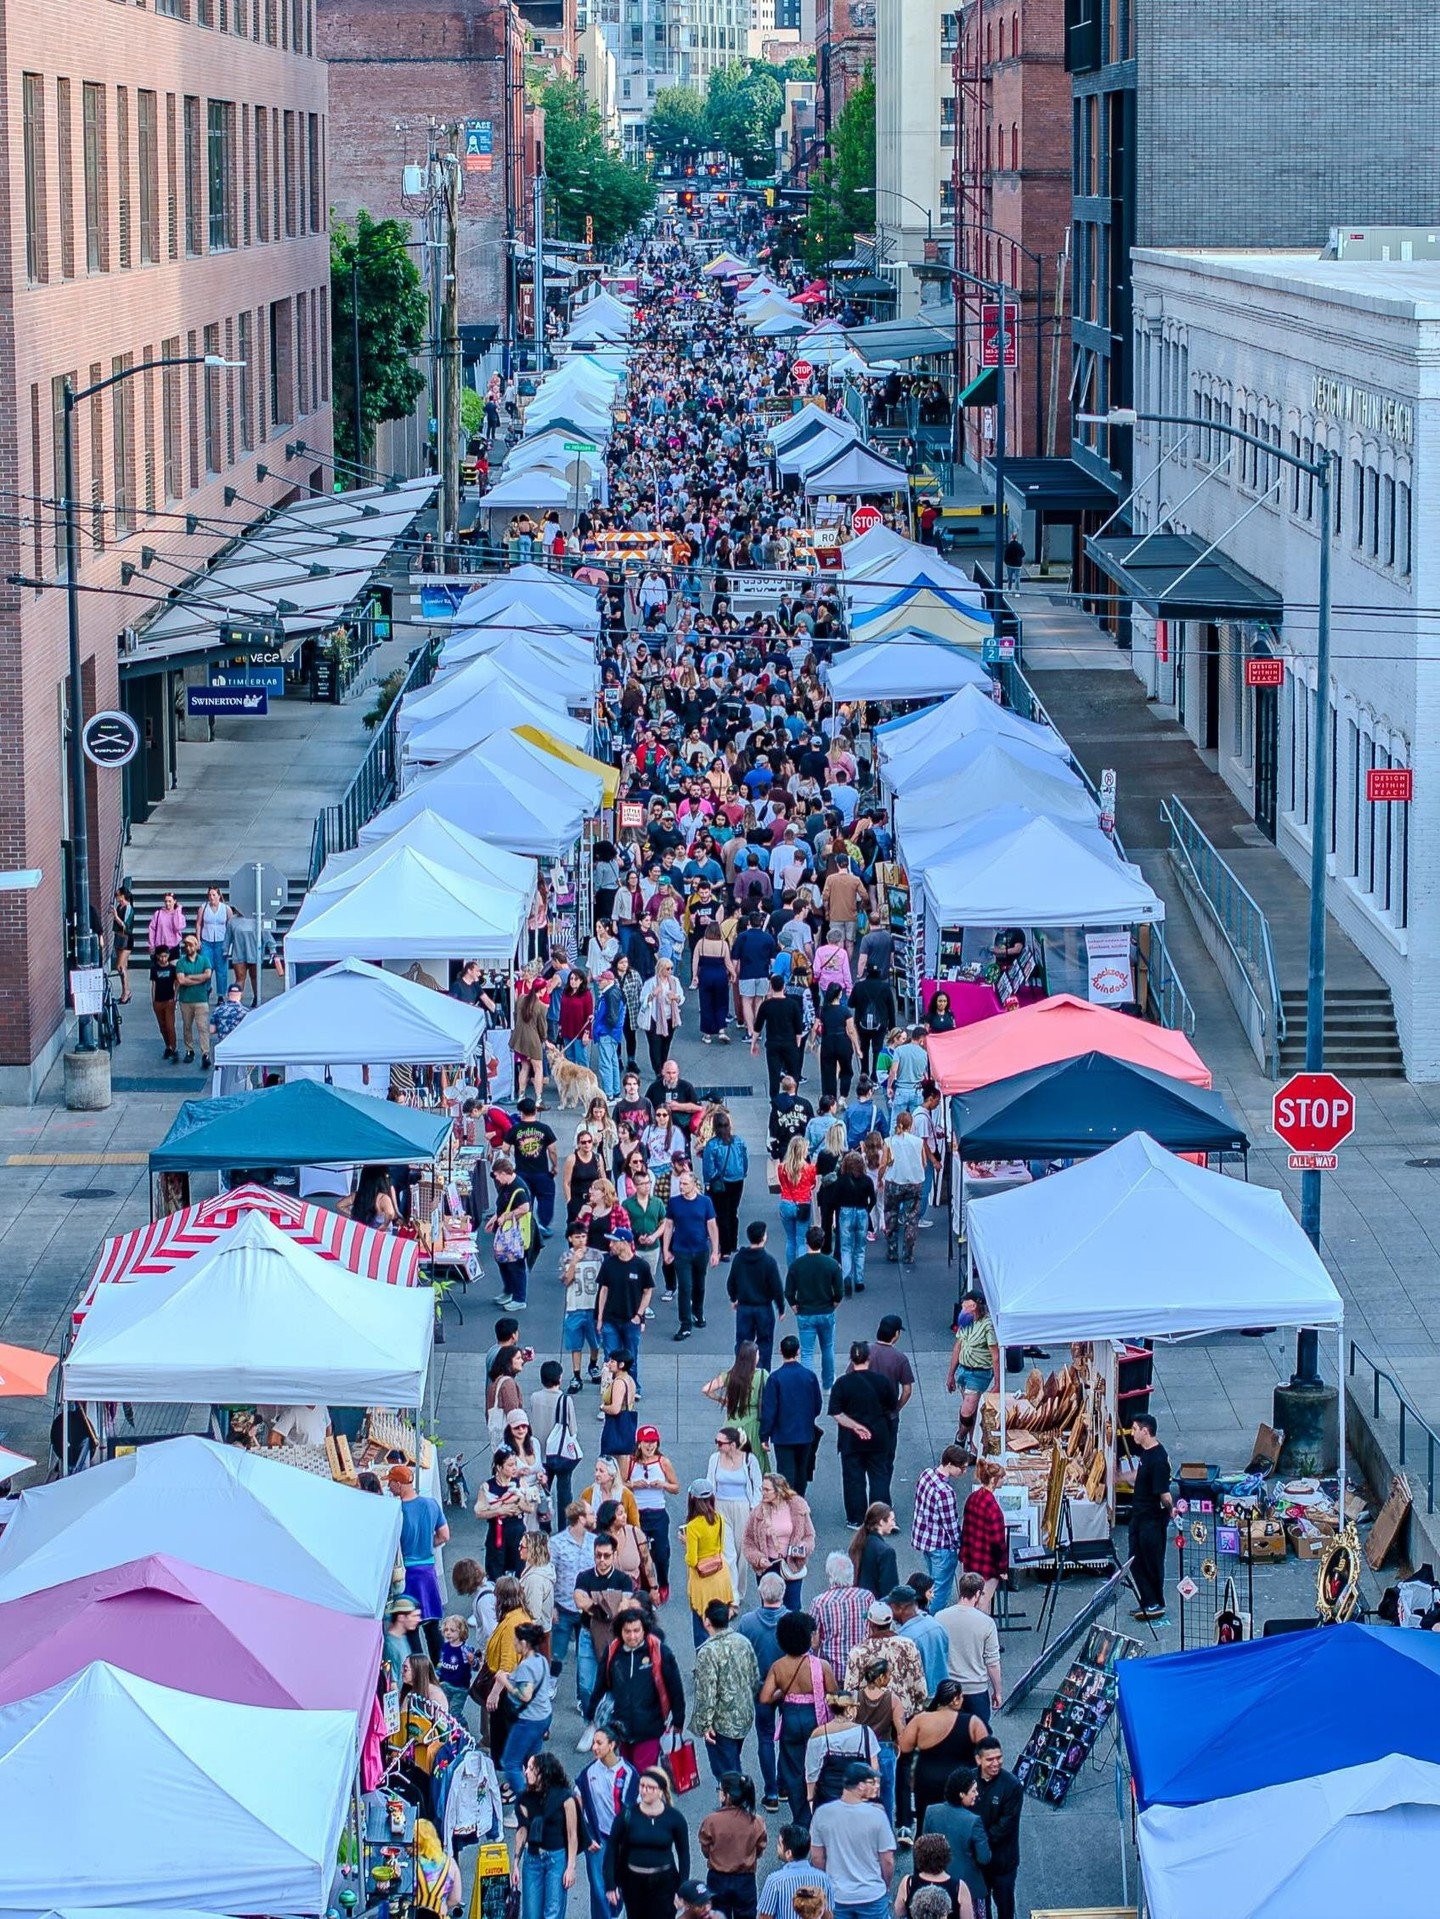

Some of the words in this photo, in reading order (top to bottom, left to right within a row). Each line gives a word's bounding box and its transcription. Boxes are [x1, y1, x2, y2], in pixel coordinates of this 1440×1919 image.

[794, 366, 811, 375] STOP
[1311, 376, 1345, 419] DESIGN
[1346, 385, 1381, 432] WITHIN
[1382, 397, 1413, 445] REACH
[854, 516, 880, 528] STOP
[250, 653, 294, 663] vacaa
[1278, 1098, 1349, 1128] STOP
[1292, 1156, 1334, 1168] ALL-WAY
